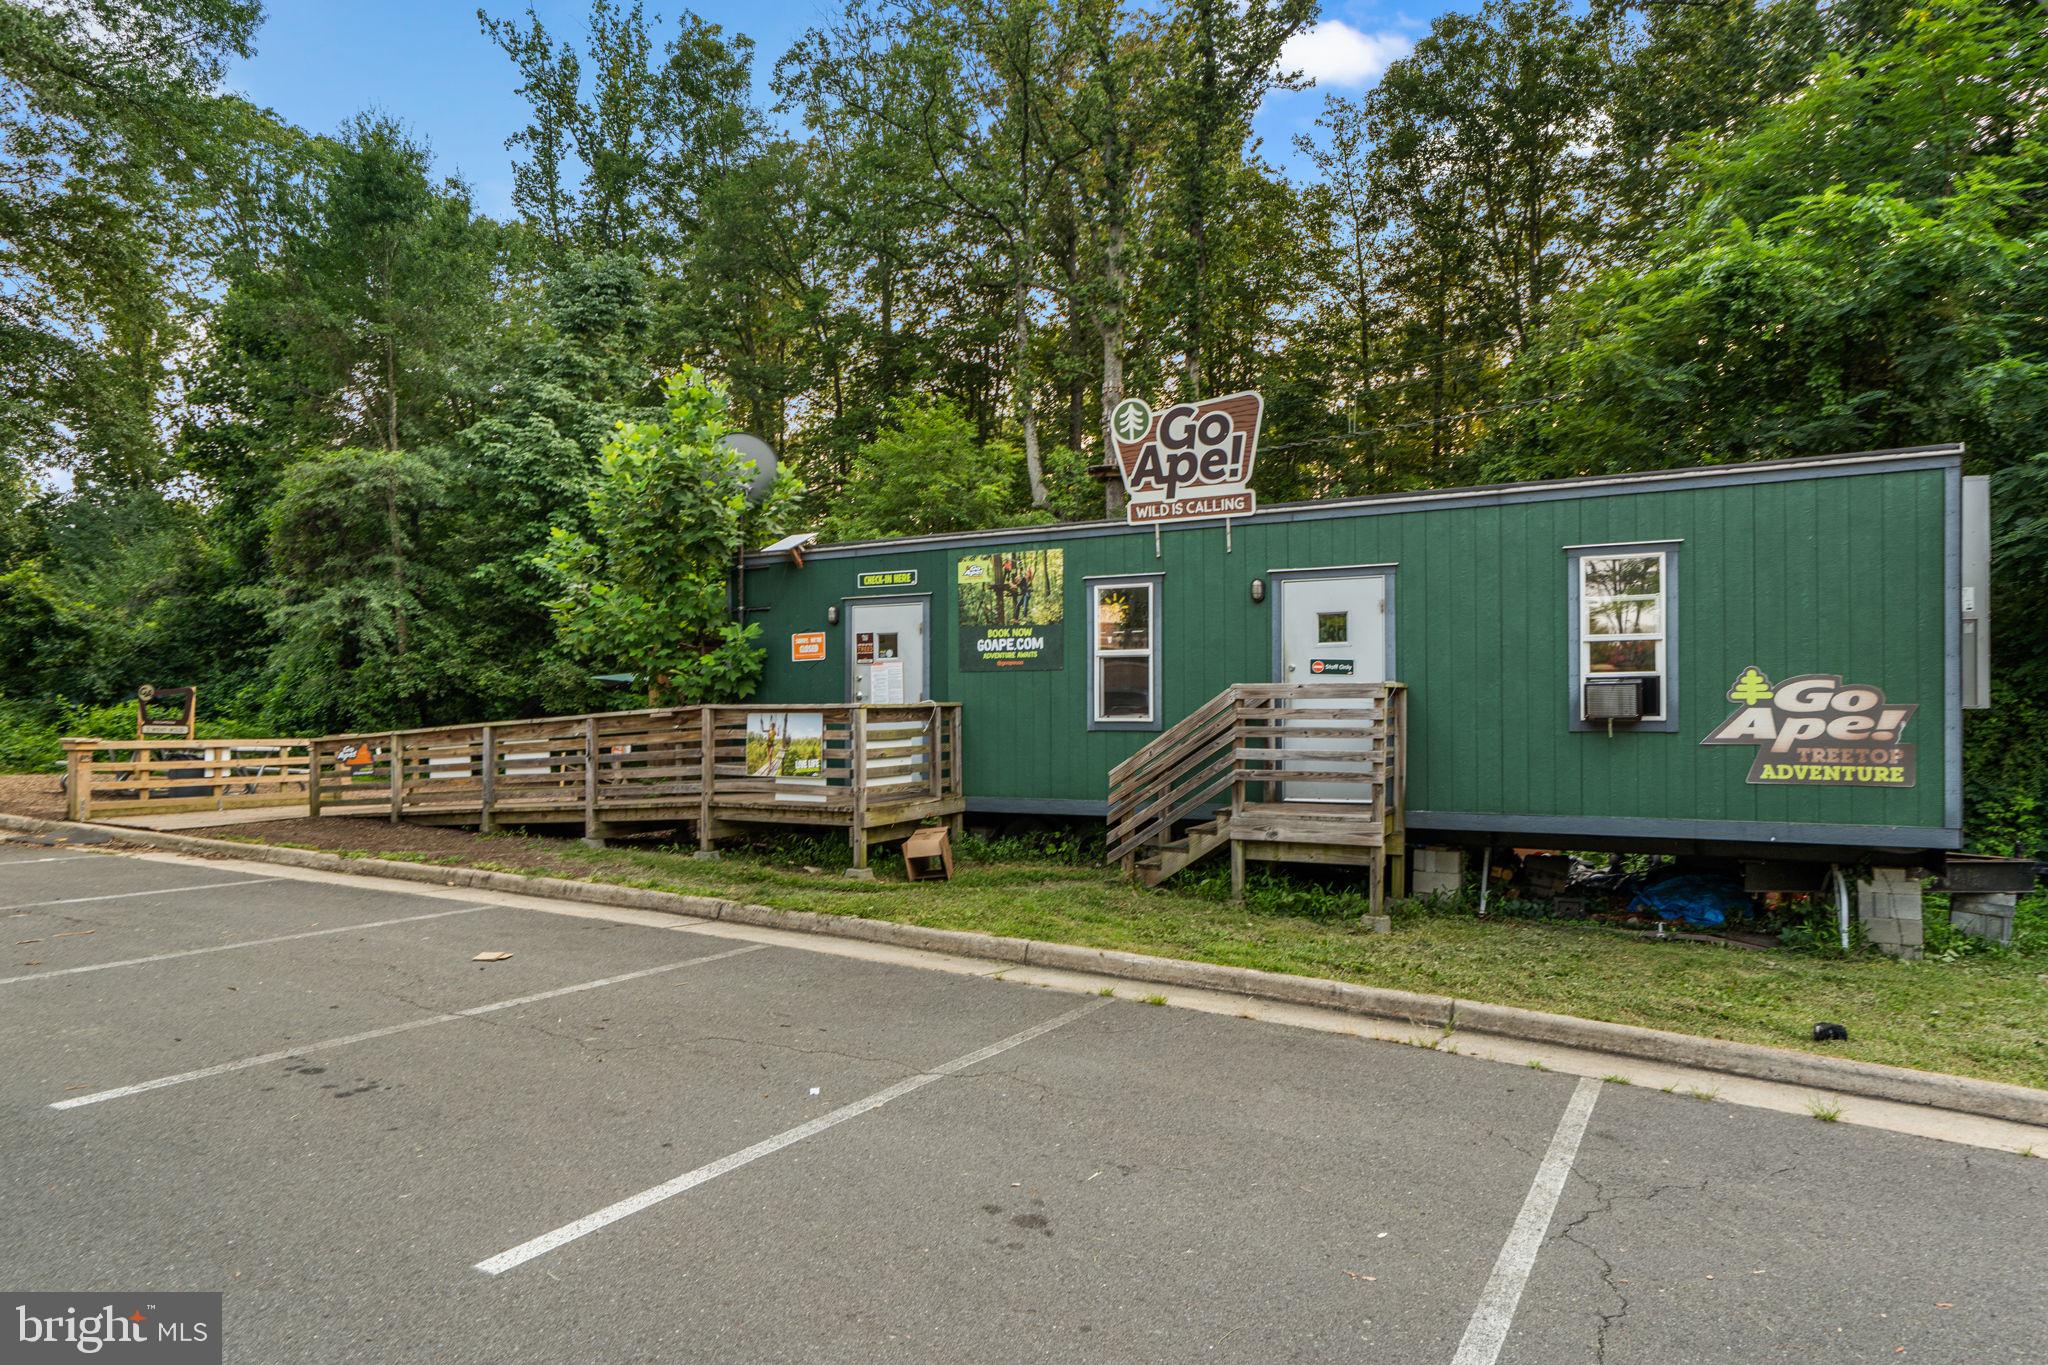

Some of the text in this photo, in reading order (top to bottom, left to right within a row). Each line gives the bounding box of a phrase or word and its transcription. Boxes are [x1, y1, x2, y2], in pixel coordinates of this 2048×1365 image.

[1160, 406, 1230, 449] Go
[1131, 434, 1243, 499] Ape!
[1136, 496, 1245, 518] WILD IS CALLING
[863, 573, 912, 585] CHECK-IN HERE
[987, 627, 1033, 638] BOOK NOW
[977, 637, 1044, 651] GOAPE.COM
[983, 651, 1038, 659] ADVENTURE AWAITS
[1339, 663, 1352, 671] Only
[1774, 679, 1878, 712] Go
[1714, 707, 1907, 752] Ape!
[1797, 747, 1904, 764] TREETOP
[1760, 764, 1904, 782] ADVENTURE
